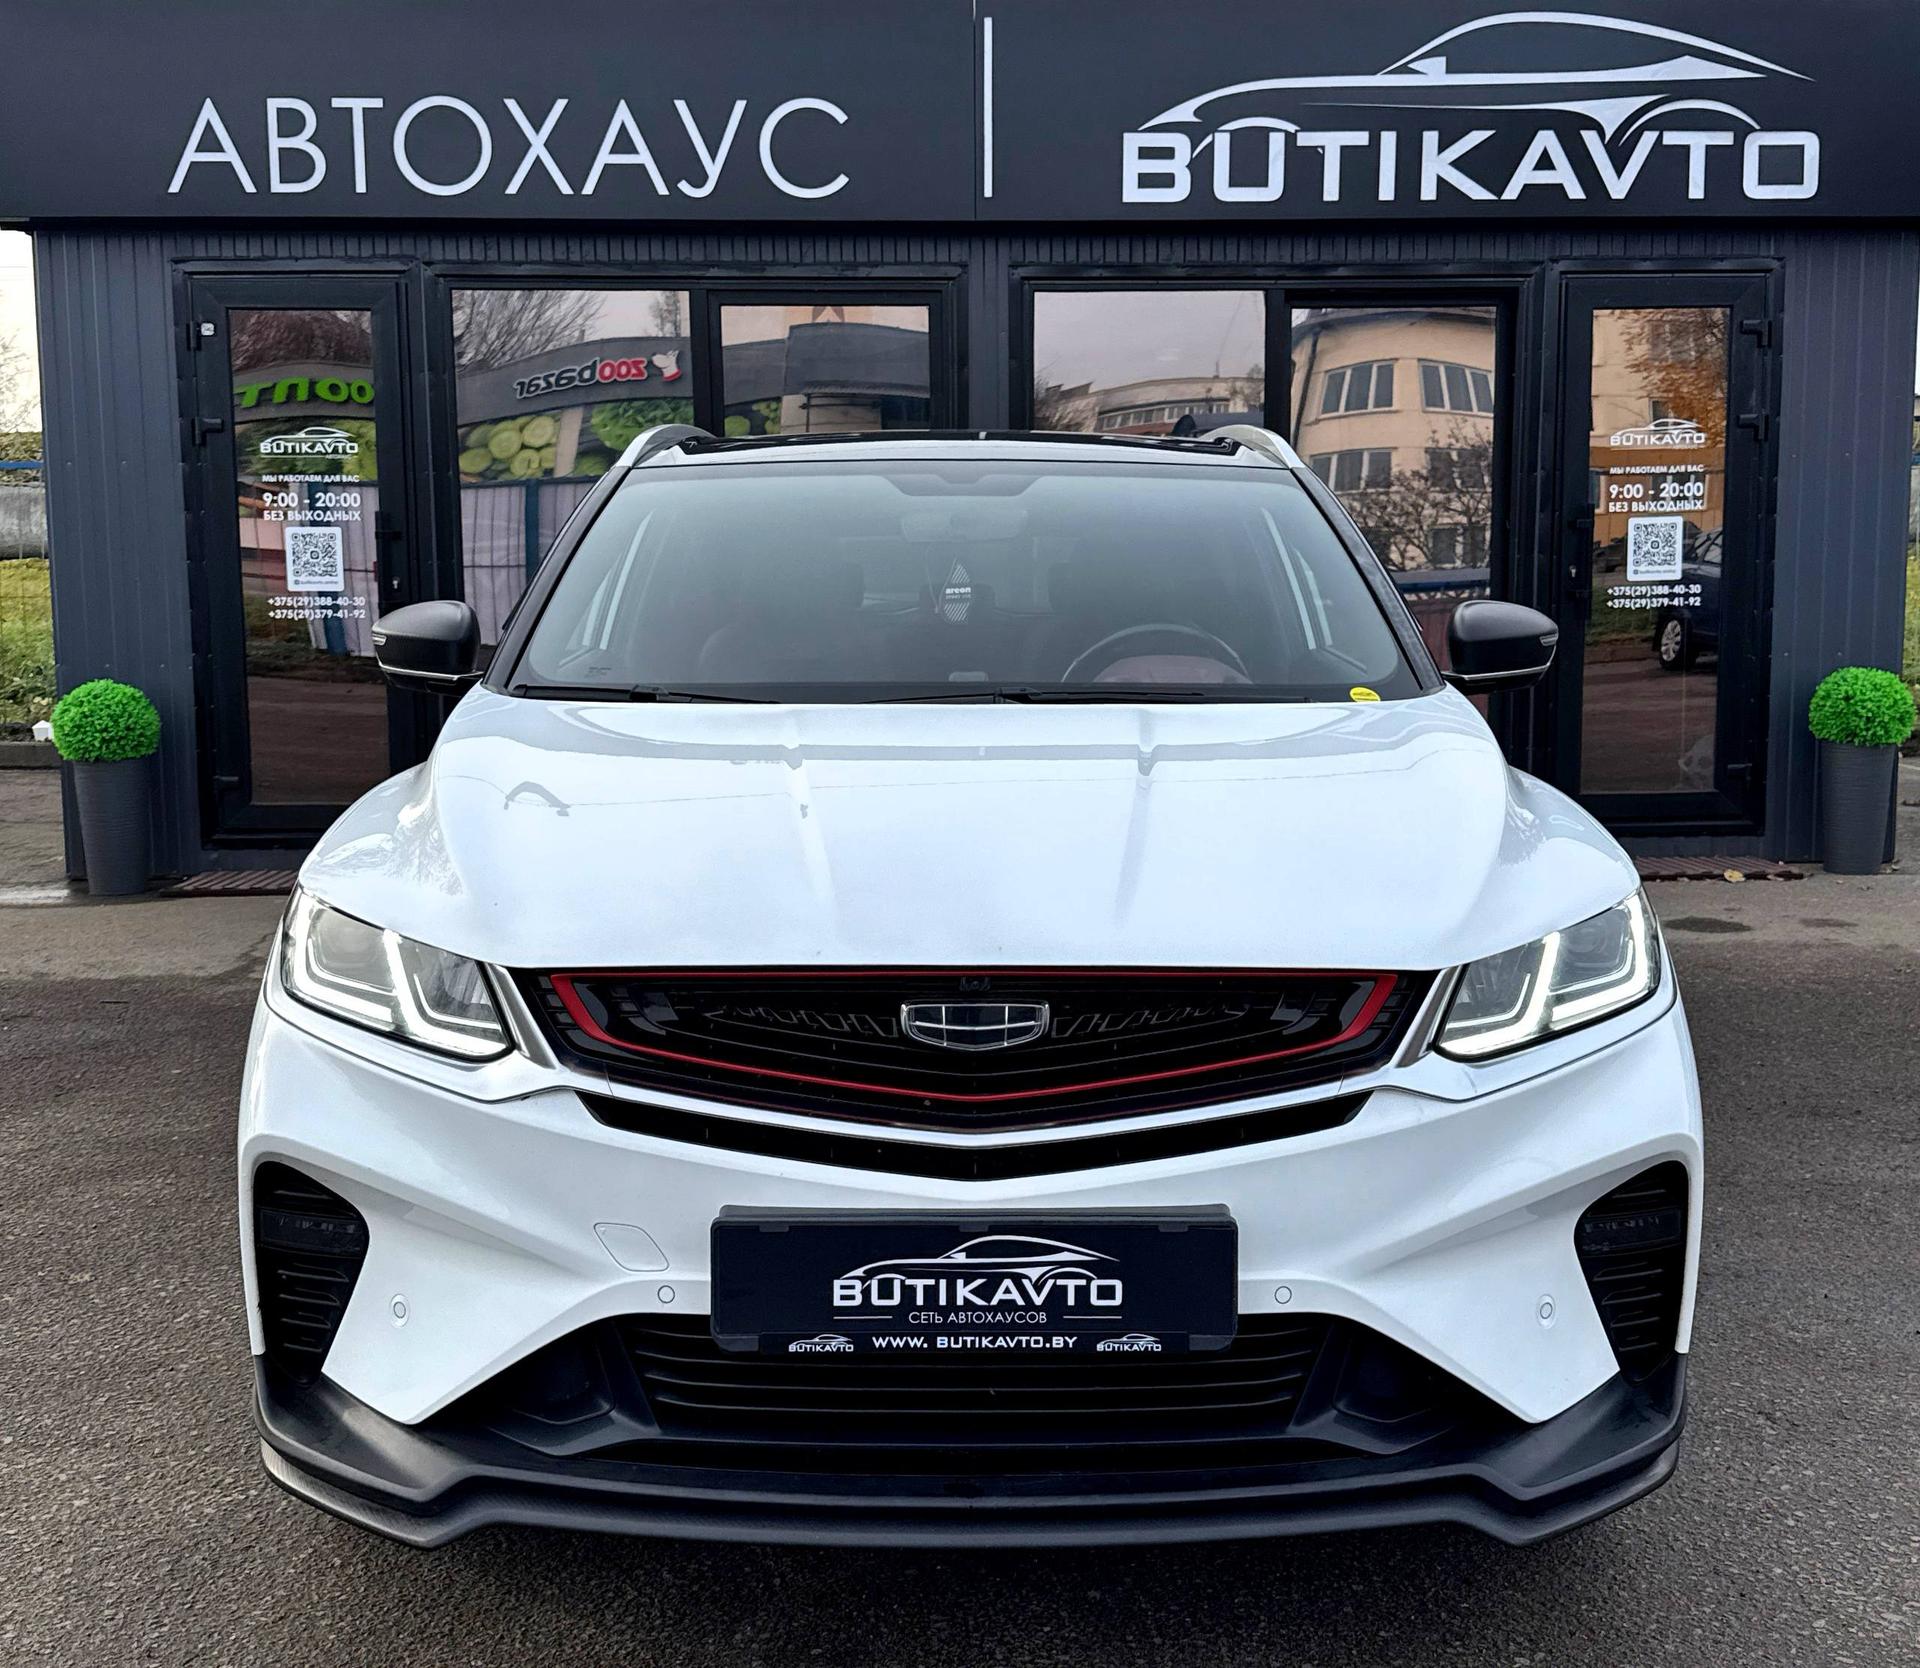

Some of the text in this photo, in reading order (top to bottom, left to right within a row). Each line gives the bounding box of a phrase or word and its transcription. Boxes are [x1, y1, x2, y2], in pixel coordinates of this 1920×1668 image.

[167, 95, 850, 199] АВТОХАУС
[1122, 129, 1820, 203] BUTIKAVTO
[1610, 432, 1706, 446] BUTIKAVTO
[260, 441, 359, 454] BUTIKAVTO
[1609, 464, 1704, 475] МЫ РАБОТАЕМ ДЛЯ ВАС
[261, 474, 360, 483] МЫ РАБОТАЕМ ДЛЯ ВАС
[1609, 484, 1644, 499] 9:00
[1659, 482, 1704, 498] 20:00
[262, 492, 299, 508] 9:00
[315, 492, 361, 508] 20:00
[1609, 500, 1703, 512] БЕЗ ВЫХОДНЫХ
[263, 510, 361, 522] БЕЗ ВЫХОДНЫХ
[1606, 597, 1701, 610] +375(29)379-41-92
[268, 609, 366, 620] +375(29)379-41-92
[832, 1278, 1123, 1306] BUTIKAVTO
[908, 1311, 1048, 1324] СЕТЬ АВТОХАУСОВ
[788, 1344, 854, 1352] BUTIKAVTO
[936, 1336, 1077, 1348] BUTIKAVTO.BY
[1096, 1343, 1162, 1352] BUTIKAVTO
